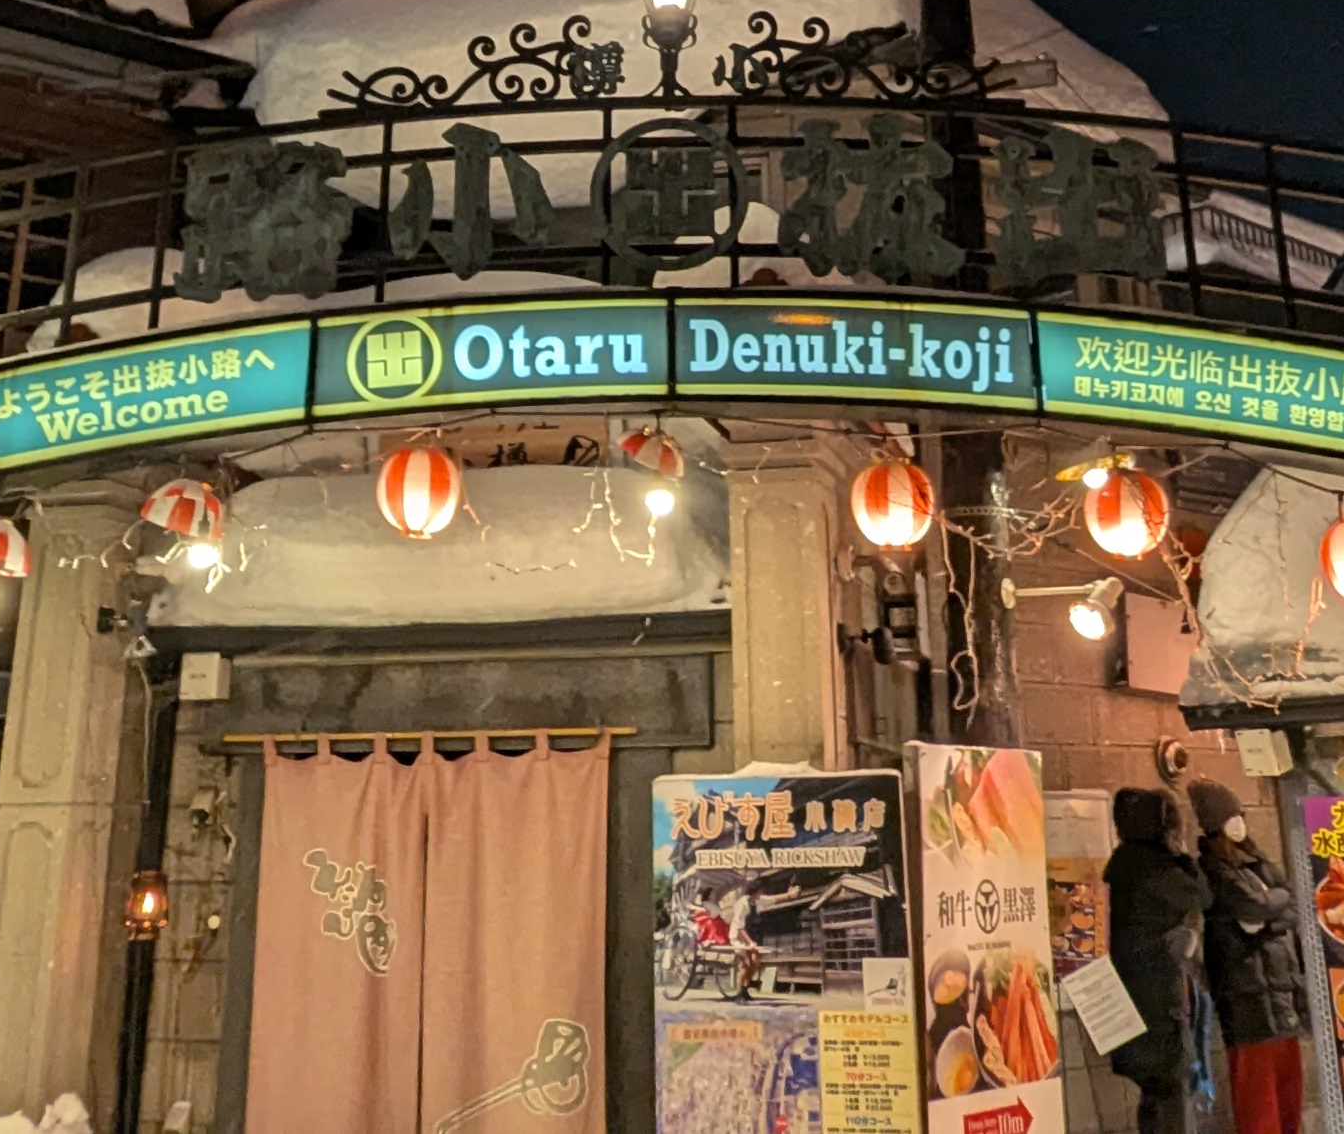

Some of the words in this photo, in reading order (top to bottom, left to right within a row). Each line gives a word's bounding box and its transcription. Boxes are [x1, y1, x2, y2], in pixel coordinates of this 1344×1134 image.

[454, 324, 648, 380] Otaru
[689, 317, 1013, 392] Denuki-koji
[36, 389, 229, 444] Welcome
[1194, 389, 1232, 415] 오신
[697, 849, 770, 869] EBISUYA
[771, 846, 866, 868] RICKSHAW
[937, 888, 972, 929] 和牛
